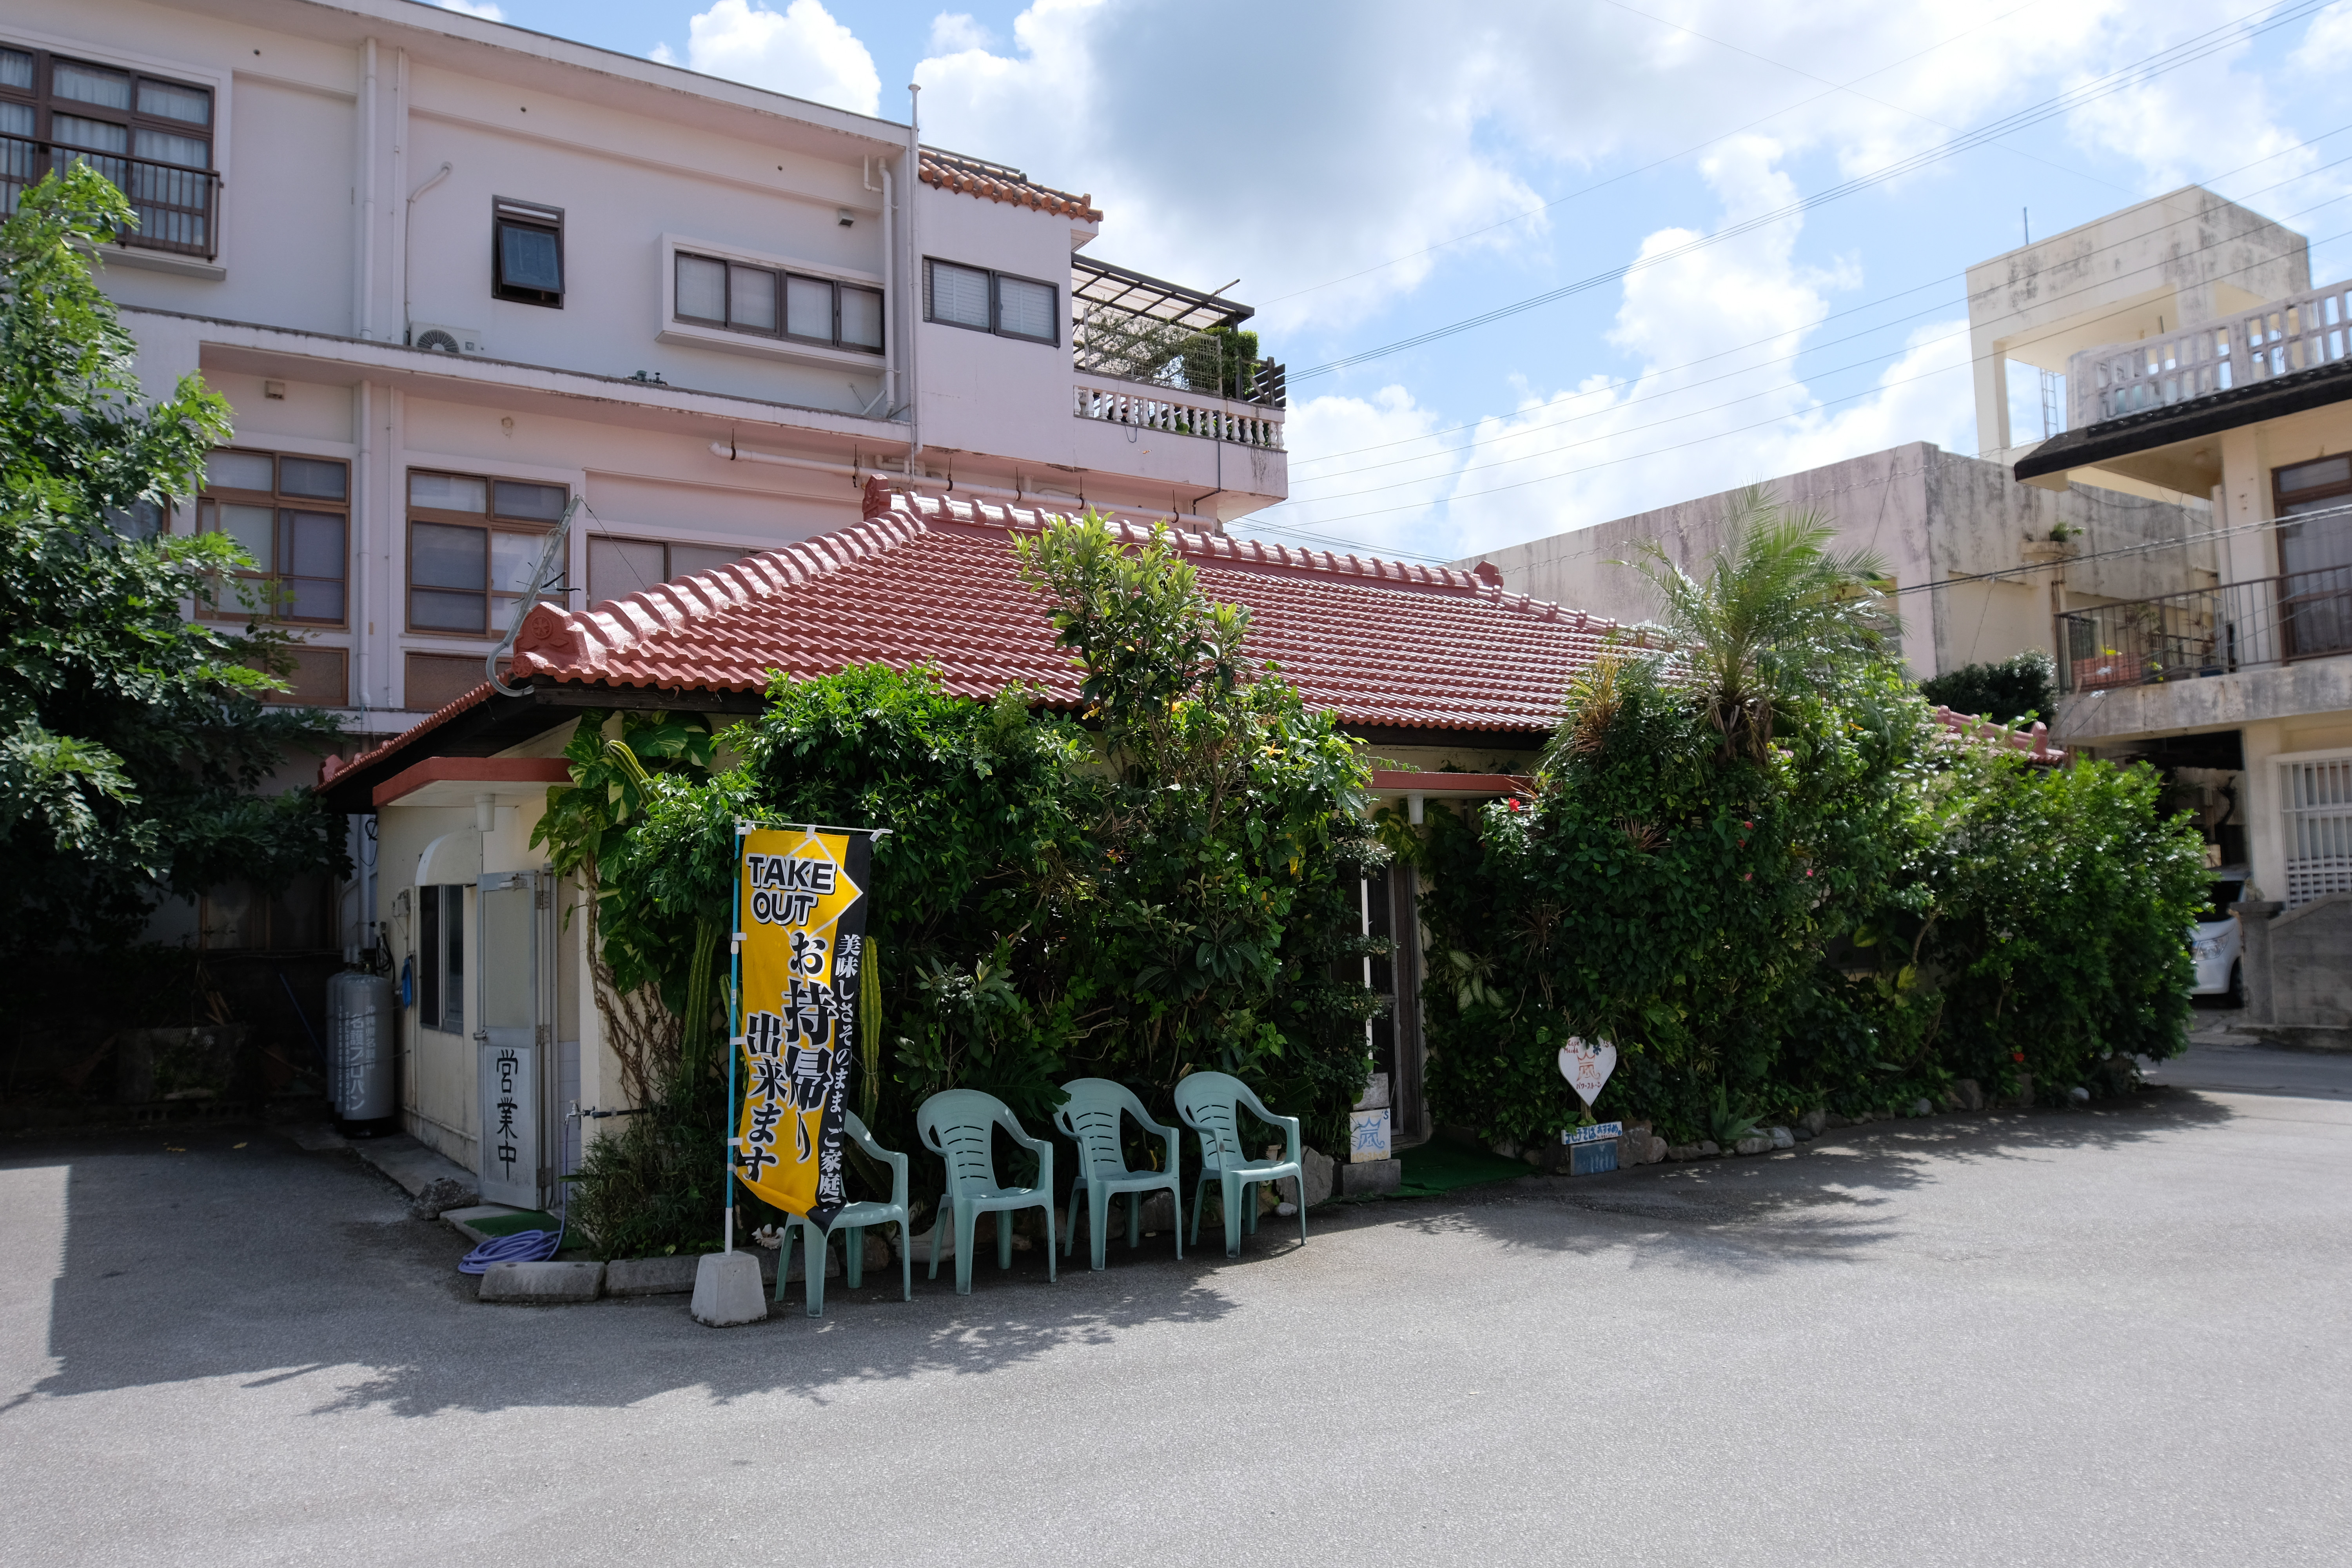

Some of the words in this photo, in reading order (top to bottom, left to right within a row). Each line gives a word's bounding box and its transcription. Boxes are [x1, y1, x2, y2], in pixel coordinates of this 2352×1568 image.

[746, 854, 837, 894] TAKE
[751, 890, 817, 925] OUT
[350, 1013, 364, 1110] 名護プロパン
[743, 1011, 787, 1182] 出来ます
[782, 931, 838, 1162] お持帰り
[496, 1049, 518, 1182] 営業中
